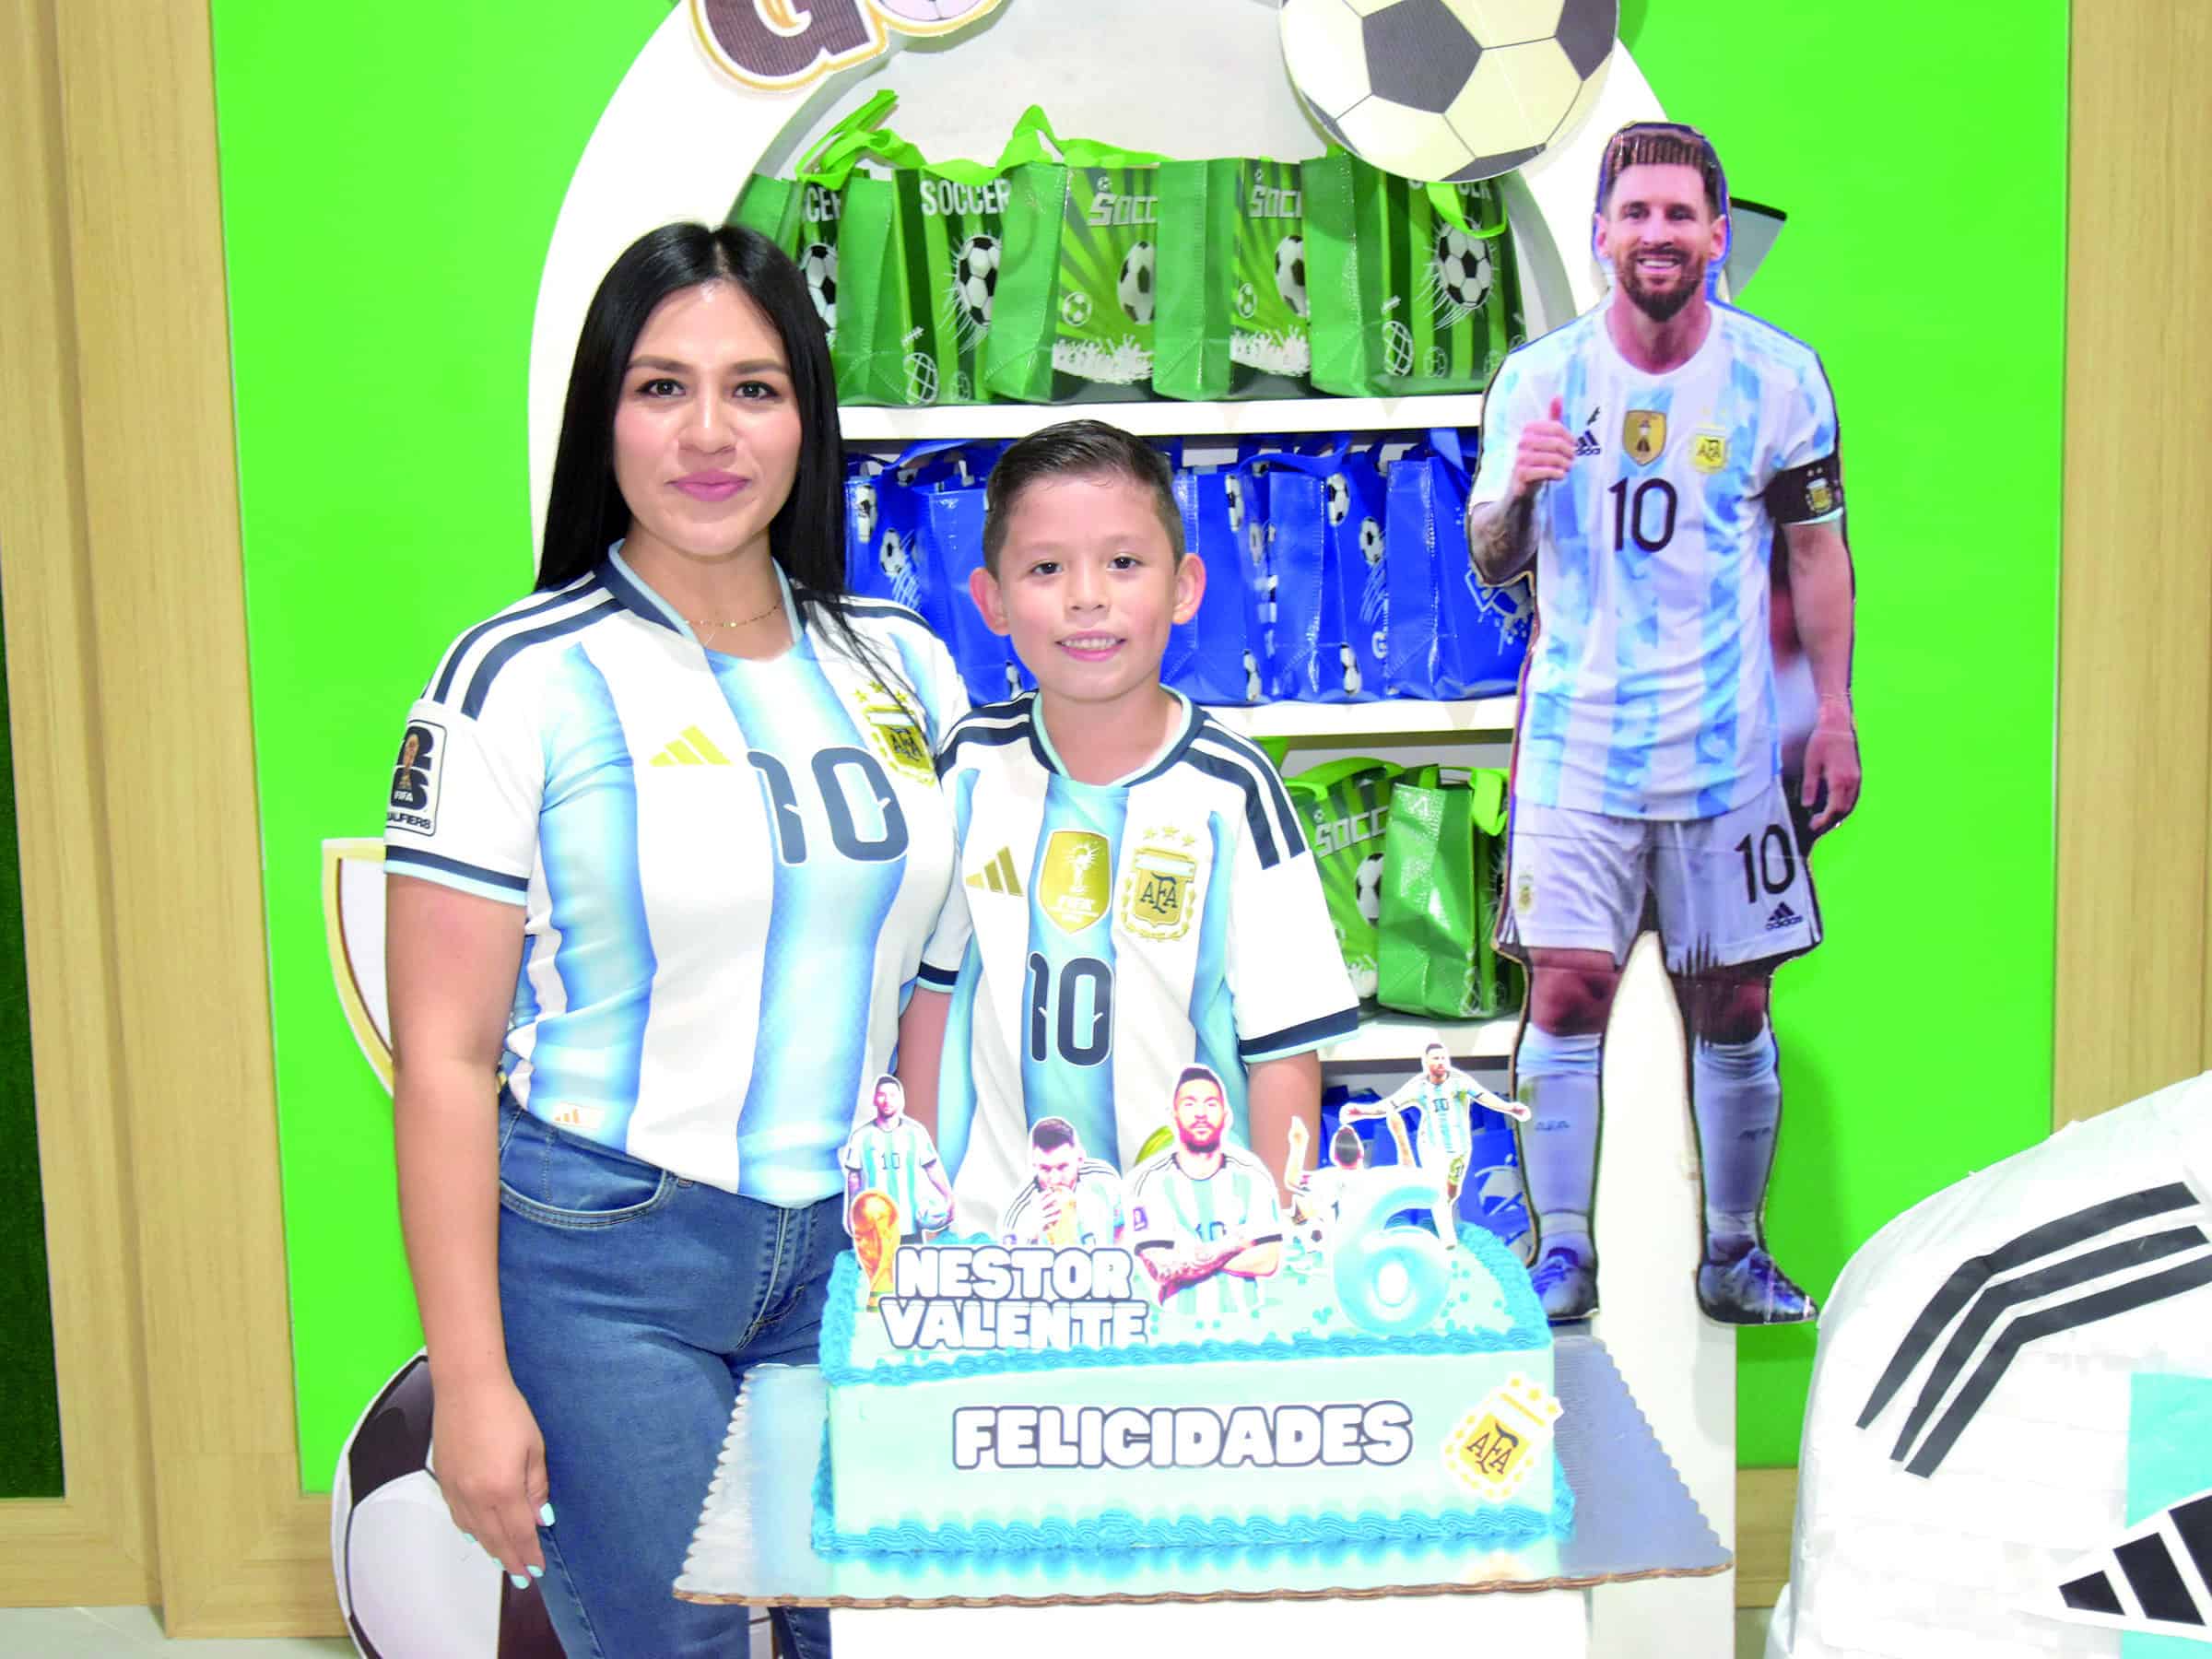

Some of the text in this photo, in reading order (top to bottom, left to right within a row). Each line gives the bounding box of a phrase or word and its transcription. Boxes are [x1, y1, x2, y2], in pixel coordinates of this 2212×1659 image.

[1607, 477, 1677, 553] 10
[394, 790, 414, 802] FIFA
[746, 747, 910, 866] 10
[1139, 872, 1179, 914] AFA
[1735, 824, 1795, 904] 10
[1029, 952, 1112, 1066] 10
[896, 1245, 1134, 1300] NESTOR
[1331, 1176, 1452, 1335] 6
[878, 1296, 1149, 1350] VALENTE
[952, 1400, 1414, 1470] FELICIDADES
[1465, 1422, 1520, 1475] AFA
